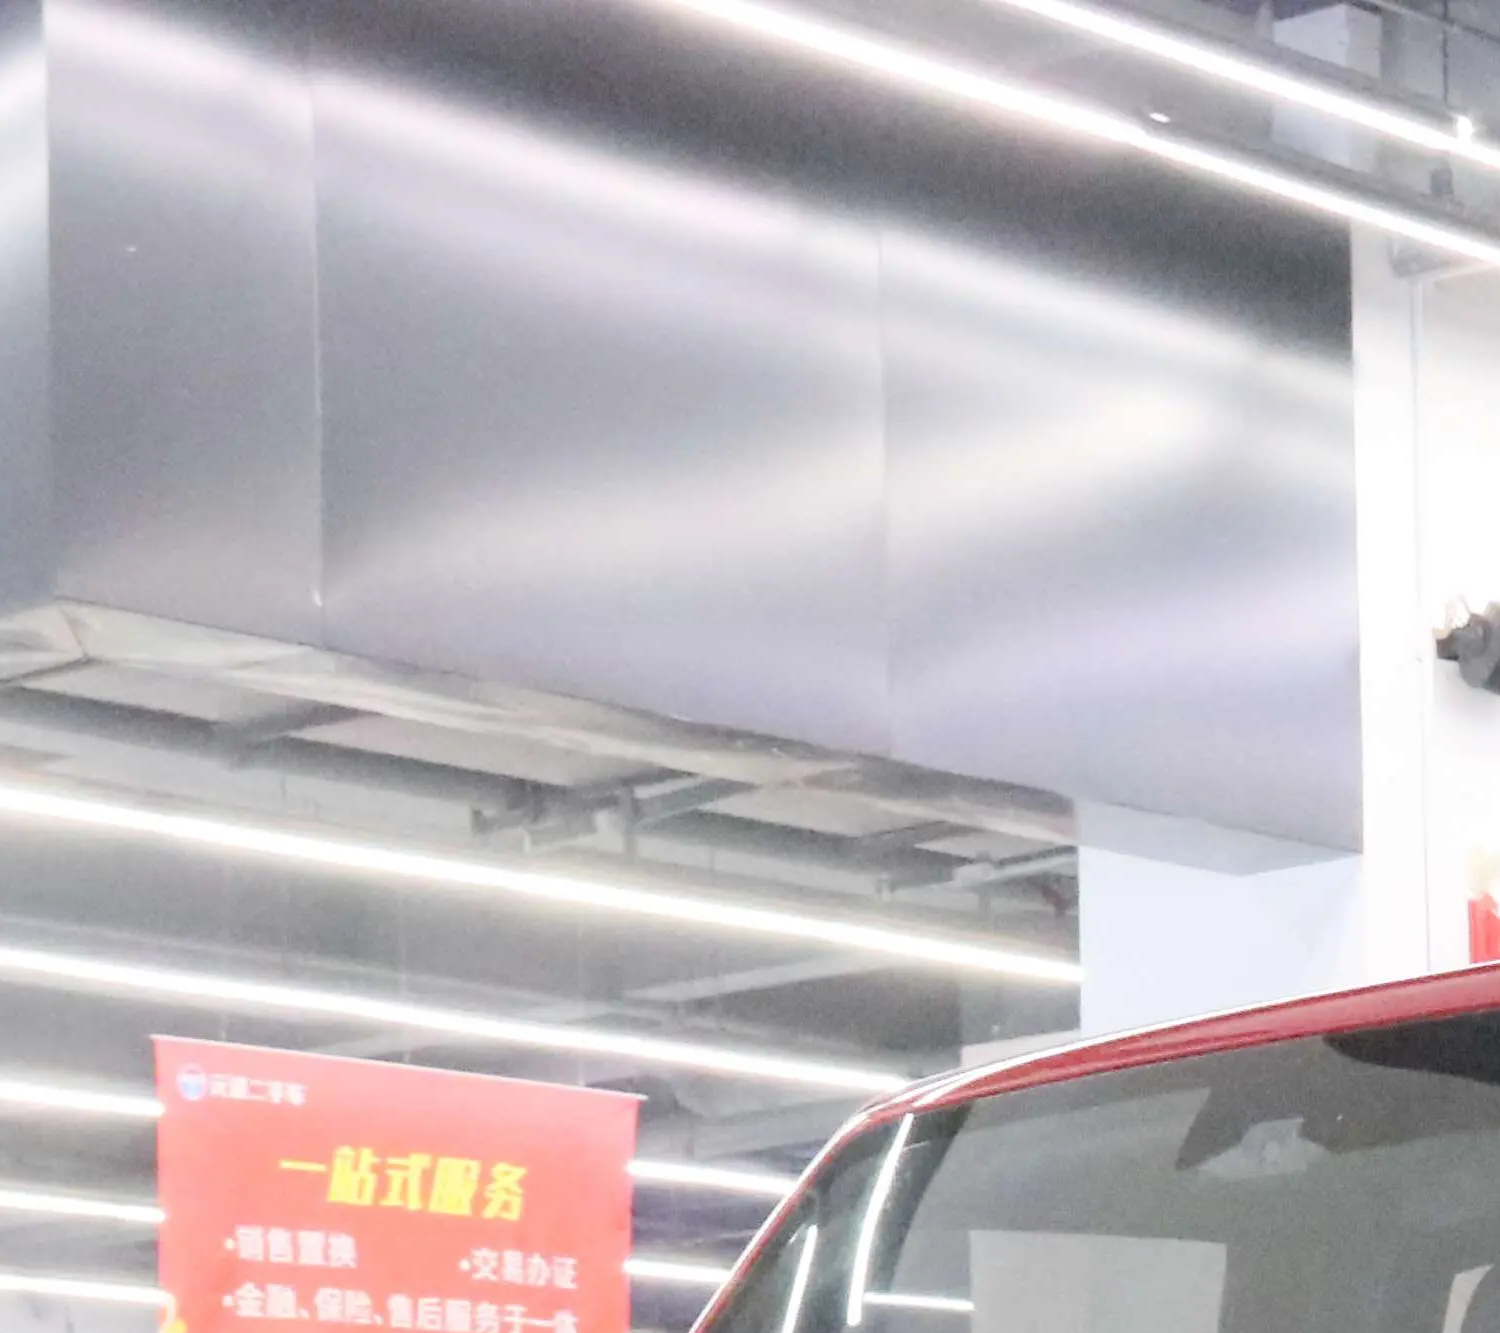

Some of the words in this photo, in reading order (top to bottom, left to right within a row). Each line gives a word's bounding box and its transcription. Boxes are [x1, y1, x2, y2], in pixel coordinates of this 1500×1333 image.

[279, 1145, 527, 1221] 一站式服务
[235, 1225, 357, 1268] 销售置换
[470, 1247, 579, 1289] 交易办证
